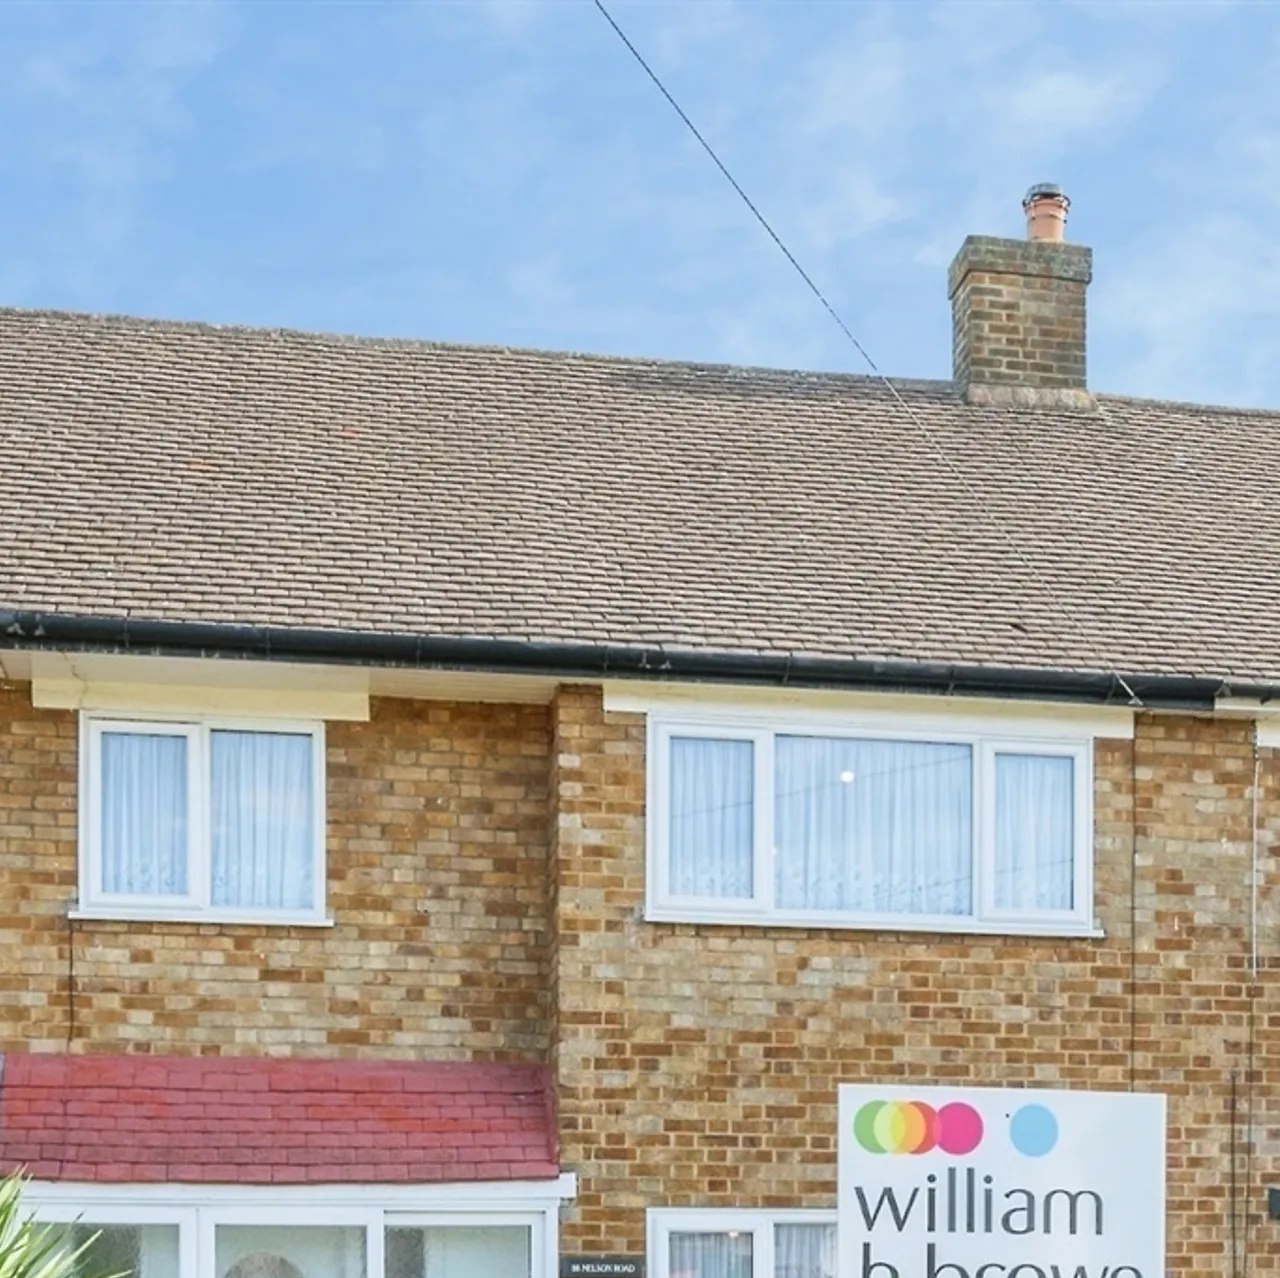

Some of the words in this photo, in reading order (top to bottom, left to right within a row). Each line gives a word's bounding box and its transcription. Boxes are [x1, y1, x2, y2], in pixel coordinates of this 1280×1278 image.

[854, 1167, 1103, 1235] william
[581, 1263, 613, 1273] NELSON
[613, 1263, 636, 1273] ROAD
